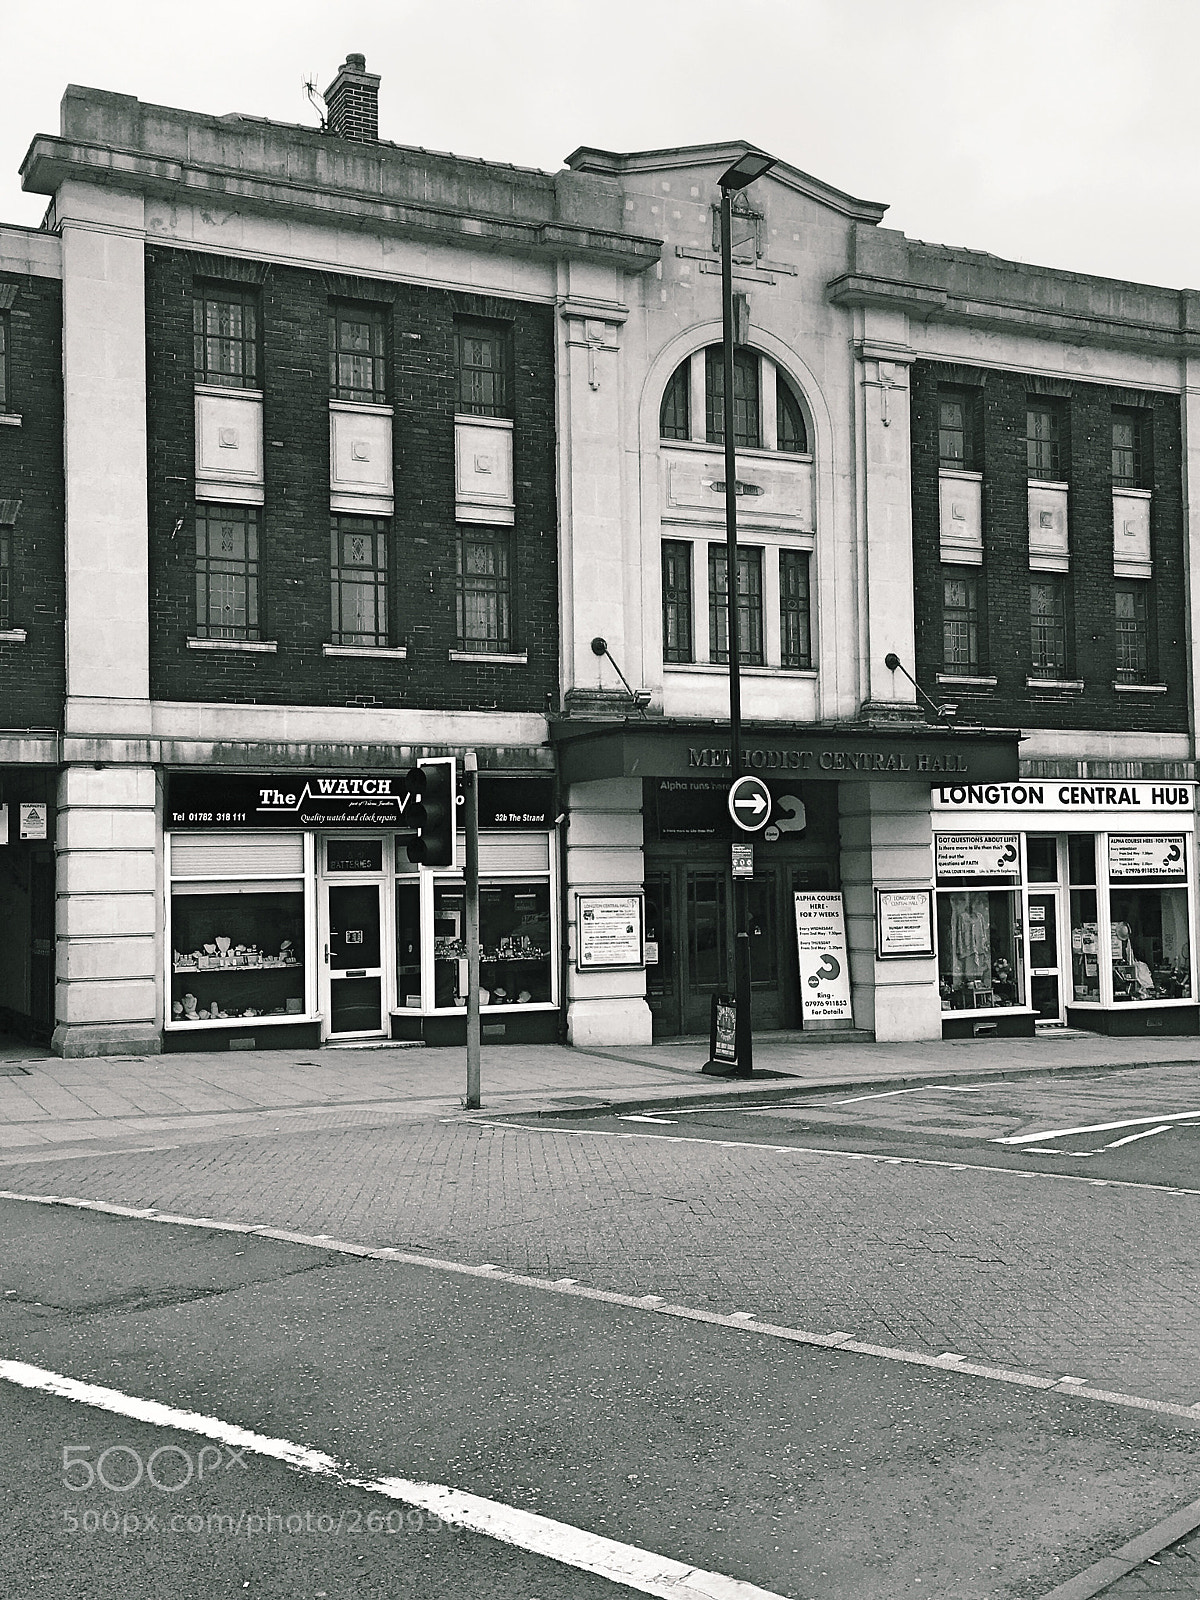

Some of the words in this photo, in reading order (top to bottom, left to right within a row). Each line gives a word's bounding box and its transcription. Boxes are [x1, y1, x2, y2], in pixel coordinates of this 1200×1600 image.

[819, 751, 910, 771] CENTRAL
[916, 753, 968, 772] HALL
[317, 779, 392, 794] WATCH
[660, 781, 688, 791] Alpha
[259, 790, 296, 805] The
[940, 785, 1044, 804] LONGTON
[1059, 786, 1141, 804] CENTRAL
[1151, 788, 1190, 805] HUB
[172, 812, 185, 821] Tel
[188, 812, 213, 821] 01782
[216, 813, 231, 821] 318
[233, 813, 246, 821] 111
[301, 812, 325, 823] Quality
[326, 812, 346, 821] watch
[346, 812, 360, 821] and
[360, 812, 377, 823] clock
[376, 814, 397, 823] repairs
[494, 814, 507, 822] 32b
[509, 814, 521, 822] The
[522, 814, 545, 822] Strand
[331, 860, 372, 869] BATTERIES
